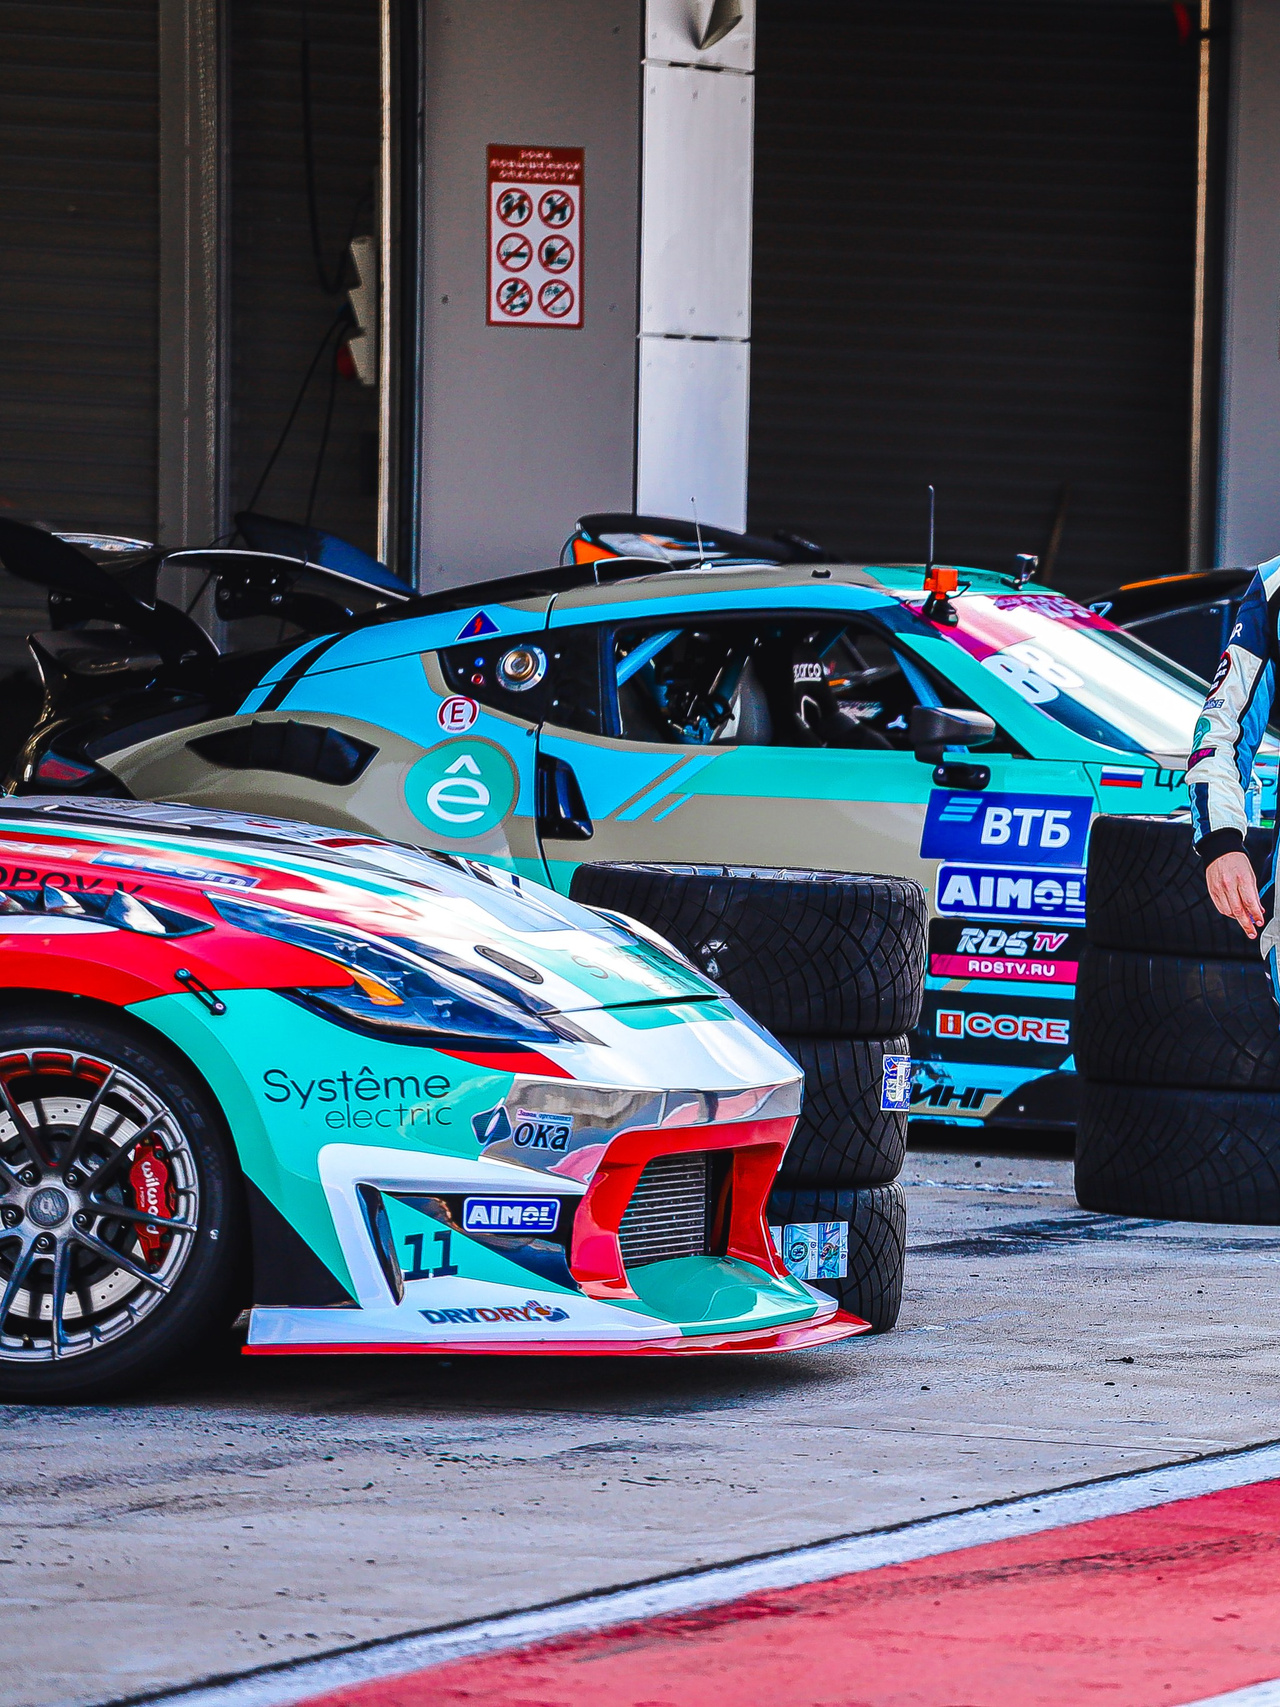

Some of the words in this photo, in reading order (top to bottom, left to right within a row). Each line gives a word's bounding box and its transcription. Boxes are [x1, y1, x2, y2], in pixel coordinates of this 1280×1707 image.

[980, 806, 1072, 849] ВТБ
[940, 874, 1086, 913] AIMOL
[968, 959, 1056, 977] RDSTV.RU
[263, 1066, 451, 1109] Système
[325, 1100, 453, 1130] electric
[140, 1161, 160, 1235] wilwod
[467, 1205, 554, 1226] AIMOL
[404, 1229, 458, 1281] 11
